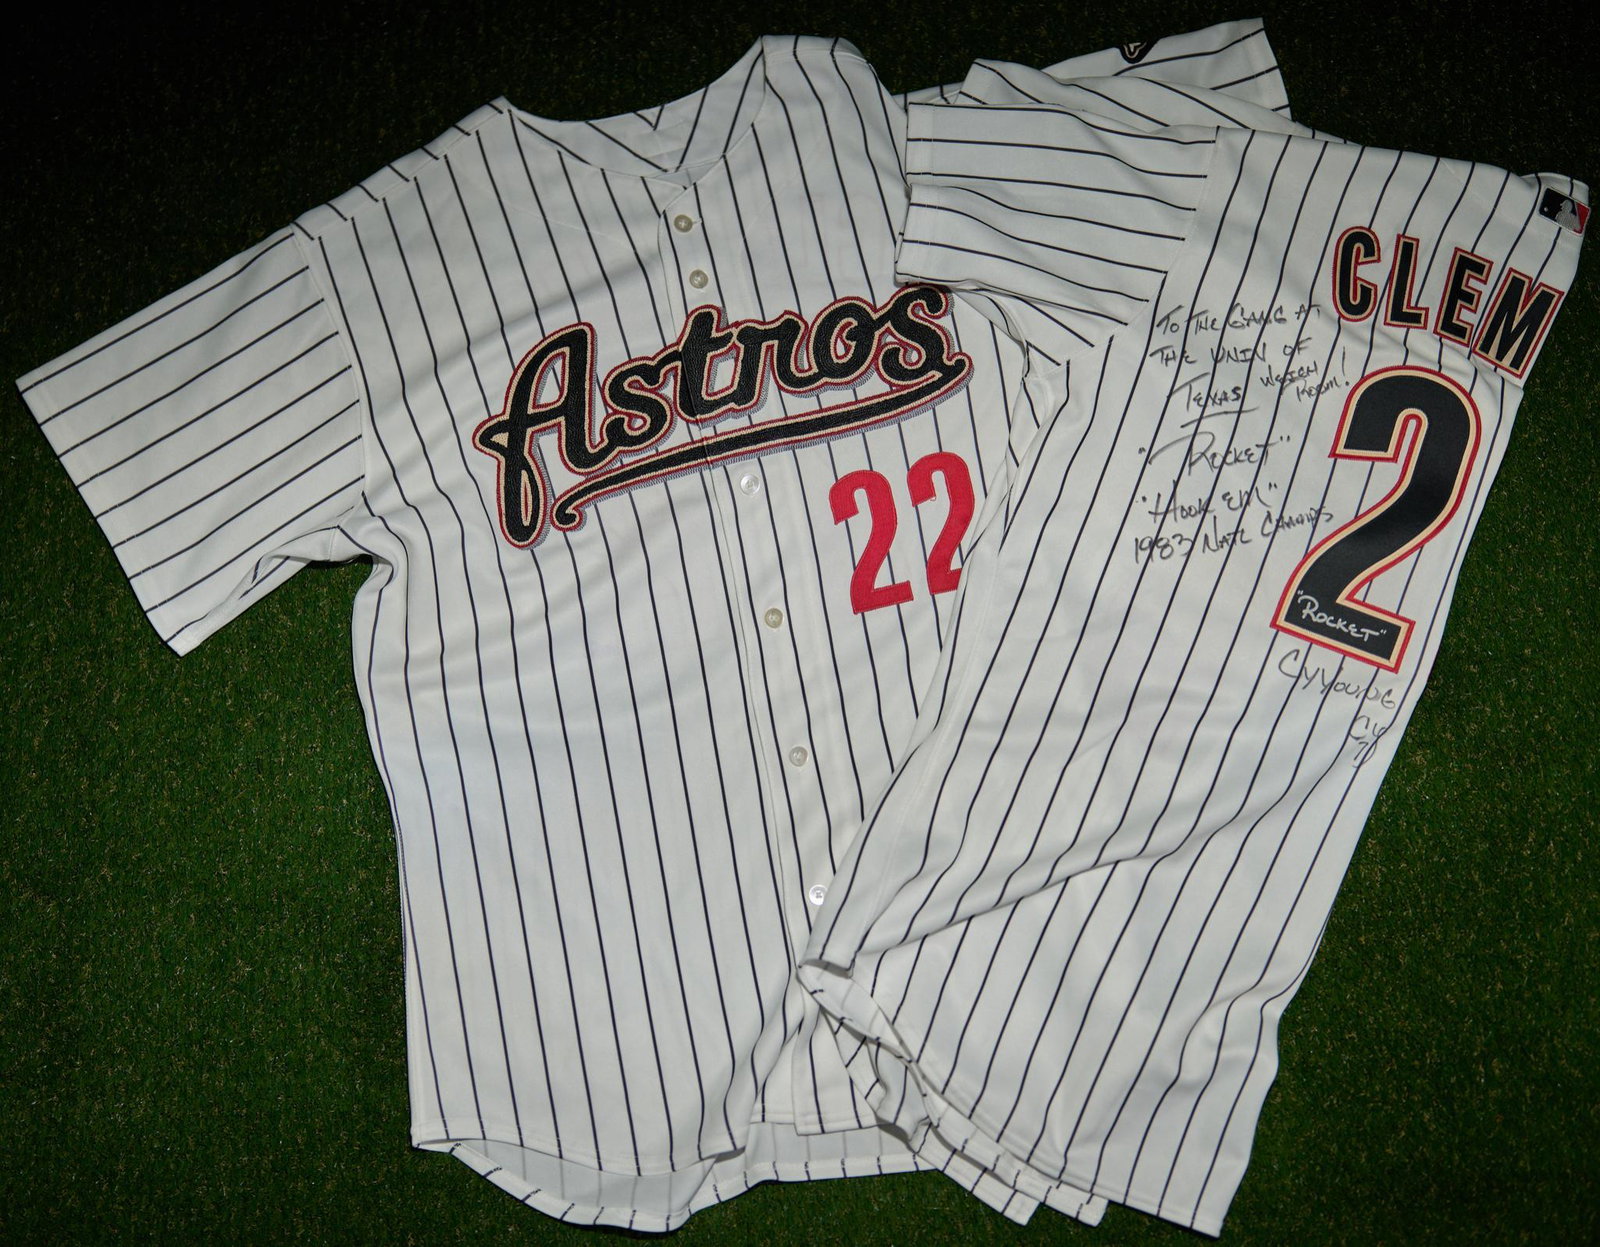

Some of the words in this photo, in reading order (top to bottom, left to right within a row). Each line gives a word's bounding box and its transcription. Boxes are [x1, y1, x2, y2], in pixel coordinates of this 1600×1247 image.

[1332, 226, 1565, 379] CLEM
[472, 282, 975, 550] Astros
[1271, 365, 1482, 674] 2
[829, 451, 975, 615] 22
